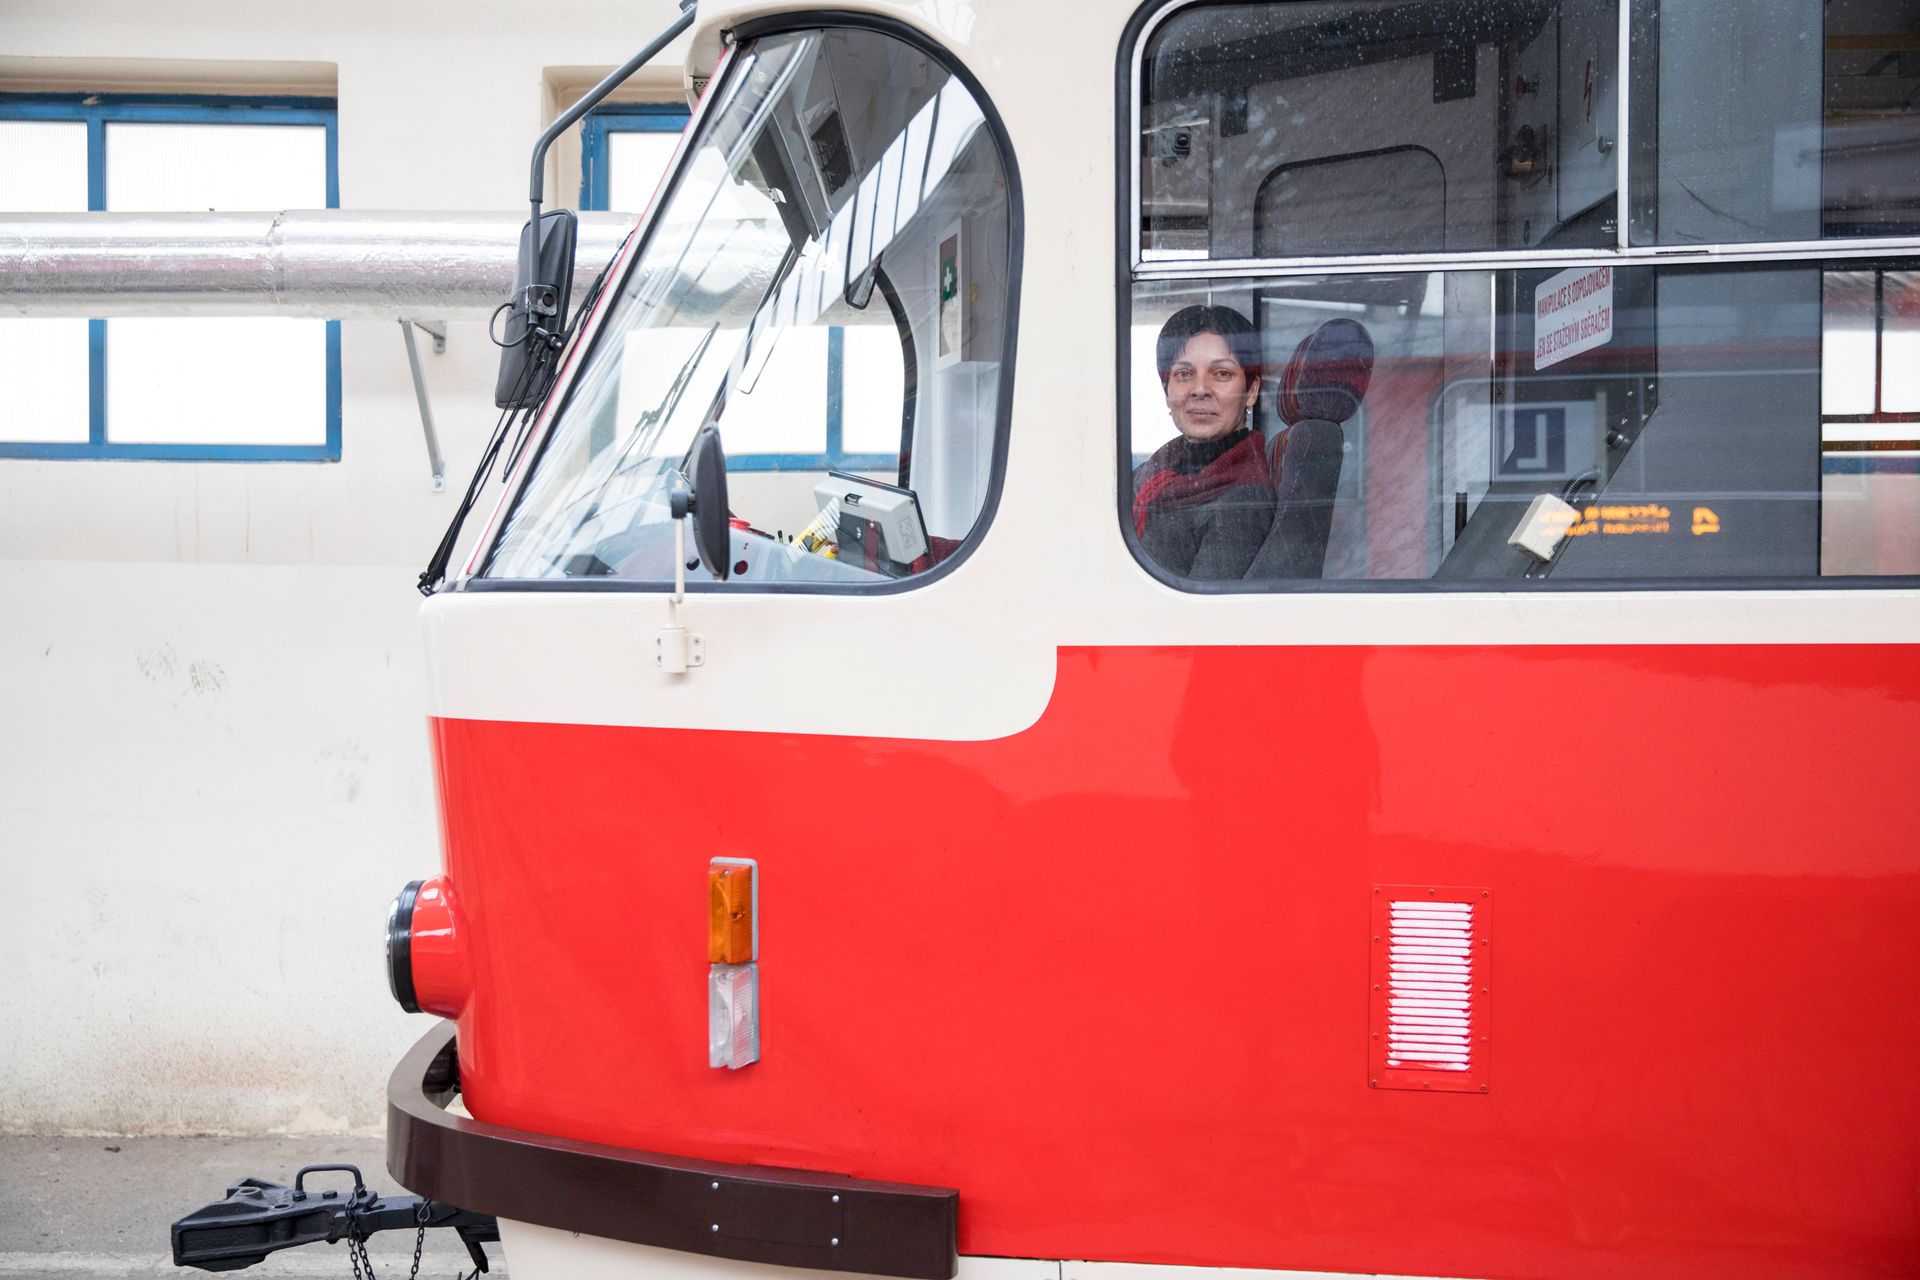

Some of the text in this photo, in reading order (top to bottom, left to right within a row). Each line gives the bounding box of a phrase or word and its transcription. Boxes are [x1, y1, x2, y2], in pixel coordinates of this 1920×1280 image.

[1537, 287, 1567, 320] MANIPULACE
[1567, 284, 1572, 306] S
[1546, 332, 1553, 354] SE
